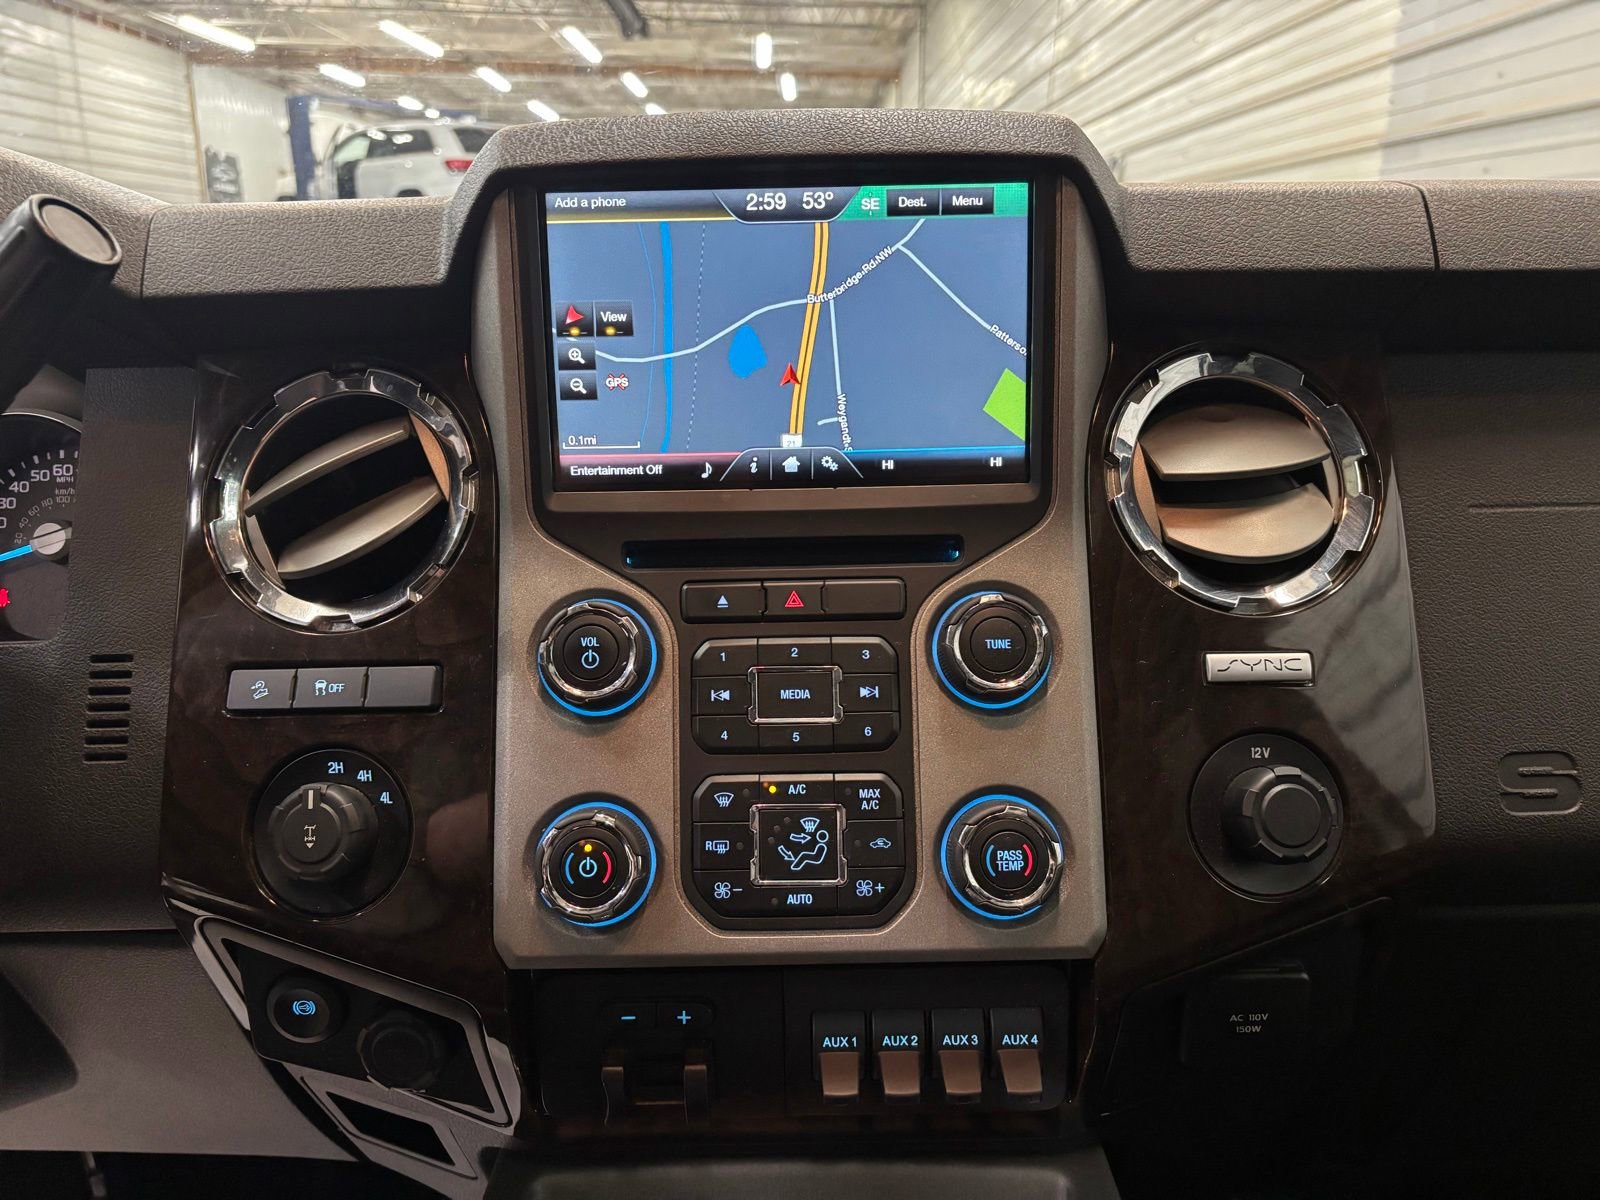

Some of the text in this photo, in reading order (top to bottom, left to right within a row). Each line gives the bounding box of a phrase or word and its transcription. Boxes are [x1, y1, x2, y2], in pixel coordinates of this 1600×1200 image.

[554, 197, 626, 210] Add a phone
[746, 192, 787, 211] 2:59
[861, 198, 880, 210] SE
[898, 196, 927, 208] Dest.
[952, 195, 983, 207] Menu
[807, 246, 893, 304] Butterbridge Rd NW
[600, 312, 627, 323] View
[605, 377, 629, 388] GPS
[568, 436, 596, 446] 0.1mi
[882, 460, 894, 470] HI
[990, 457, 1002, 467] HI
[53, 464, 73, 476] 60
[570, 464, 663, 476] Entertainment Off
[31, 470, 50, 482] 50
[8, 481, 30, 493] 40
[41, 498, 53, 507] 80
[28, 505, 40, 516] 60
[19, 517, 29, 528] 40
[14, 533, 23, 544] 20
[581, 637, 600, 647] VOL
[985, 639, 1012, 649] TUNE
[720, 652, 726, 661] 1
[791, 648, 798, 658] 2
[862, 650, 870, 659] 3
[1217, 658, 1303, 672] SYNC
[329, 683, 345, 693] OFF
[780, 689, 811, 700] MEDIA
[721, 730, 728, 741] 4
[793, 732, 800, 742] 5
[865, 727, 872, 737] 6
[1250, 747, 1270, 759] 12V
[328, 762, 344, 774] 2H
[357, 771, 372, 782] 4H
[788, 784, 807, 795] A/C
[859, 789, 880, 799] MAX
[380, 792, 393, 804] 4L
[861, 800, 879, 810] A/C
[997, 850, 1023, 861] PASS
[996, 861, 1024, 871] TEMP
[787, 894, 813, 905] AUTO
[1230, 1013, 1269, 1022] AC 110V
[1236, 1025, 1262, 1033] 150W
[822, 1036, 857, 1048] AUX 1
[882, 1035, 919, 1047] AUX 2
[942, 1035, 979, 1046] AUX 3
[1002, 1034, 1039, 1045] AUX 4
